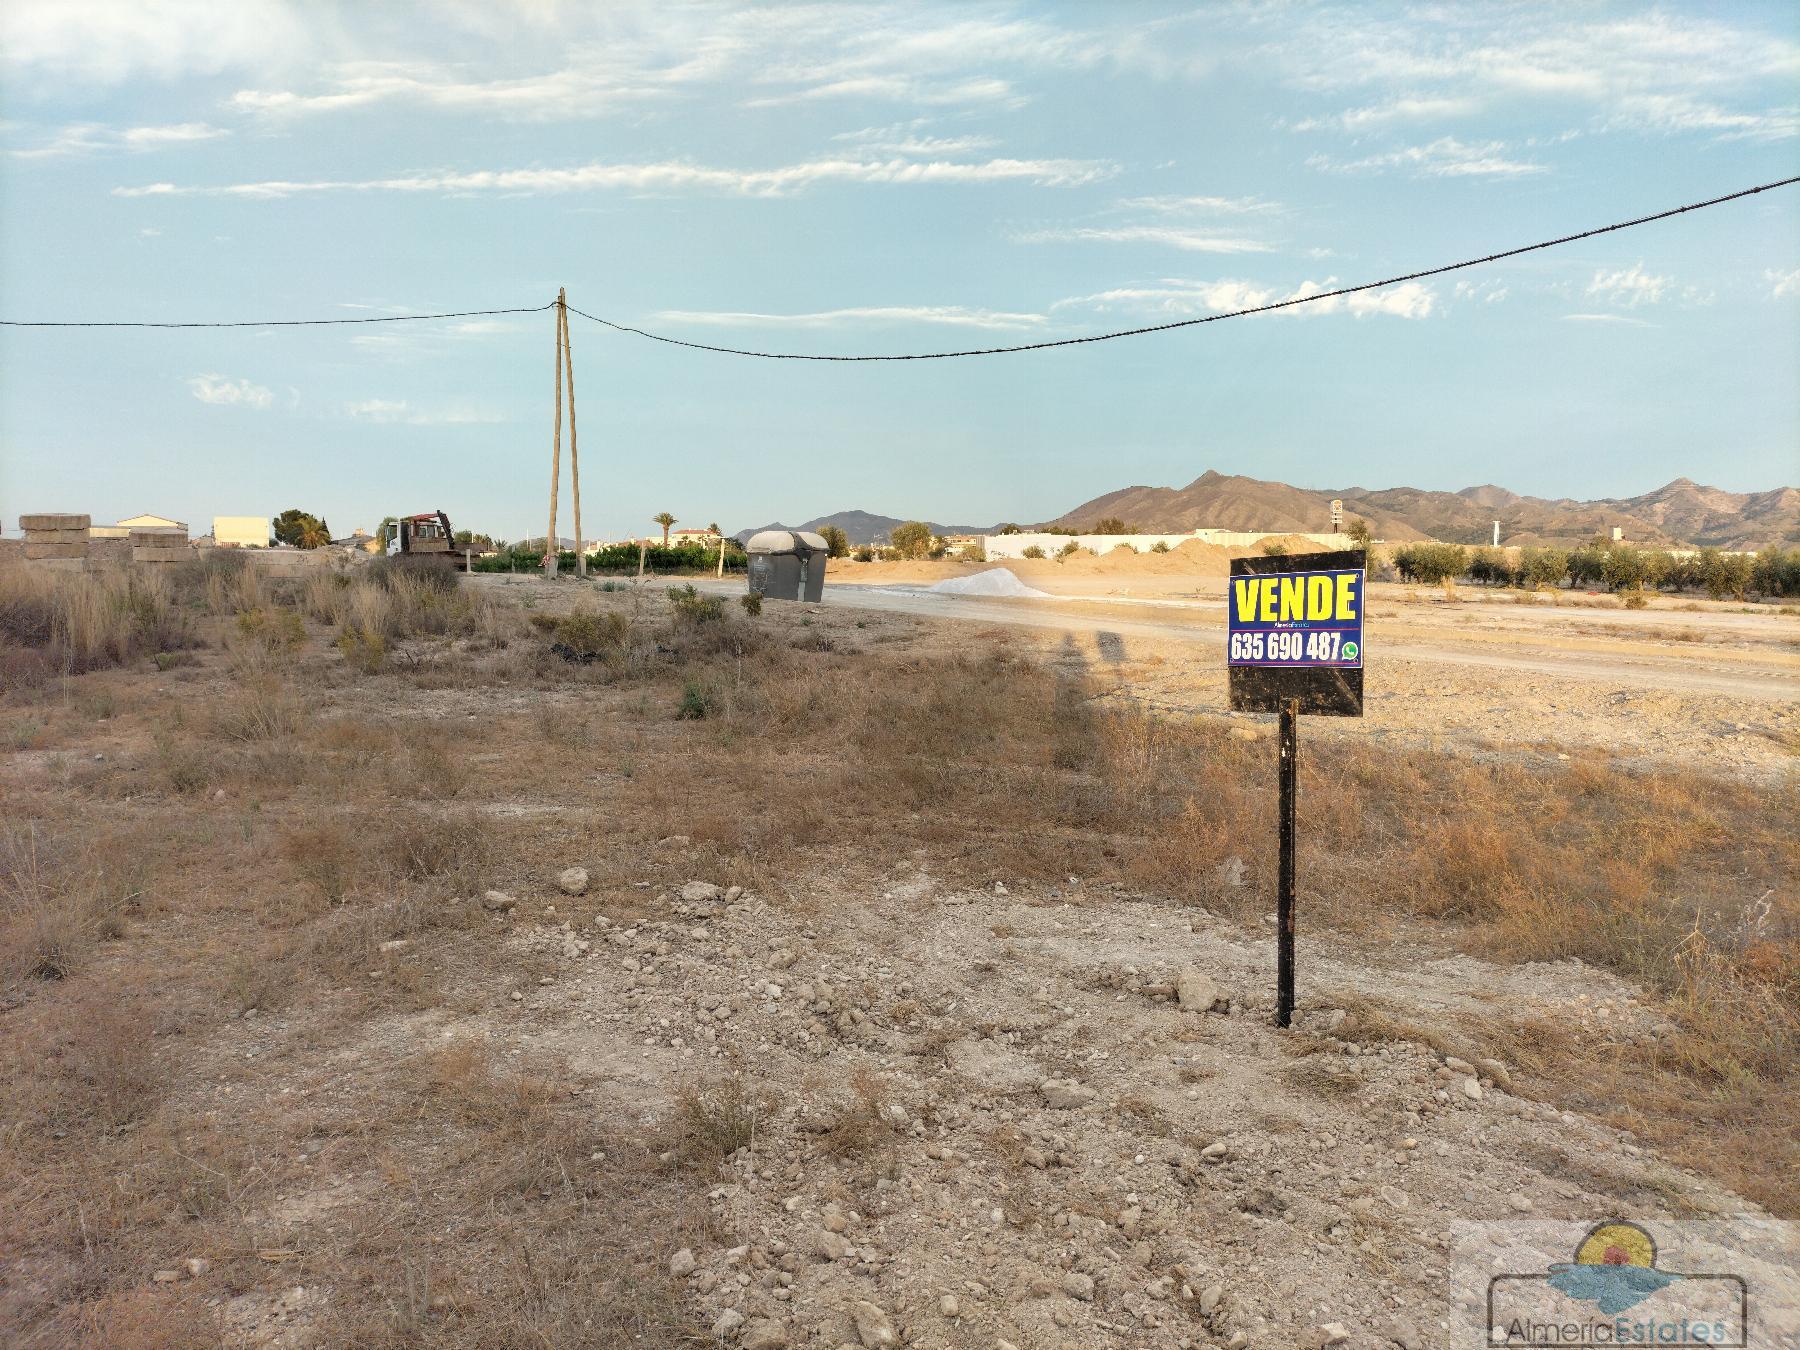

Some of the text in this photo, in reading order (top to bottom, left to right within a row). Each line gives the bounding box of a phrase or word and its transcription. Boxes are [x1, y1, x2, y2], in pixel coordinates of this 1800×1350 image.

[1235, 574, 1356, 622] VENDE
[1231, 632, 1340, 660] 635 690 487
